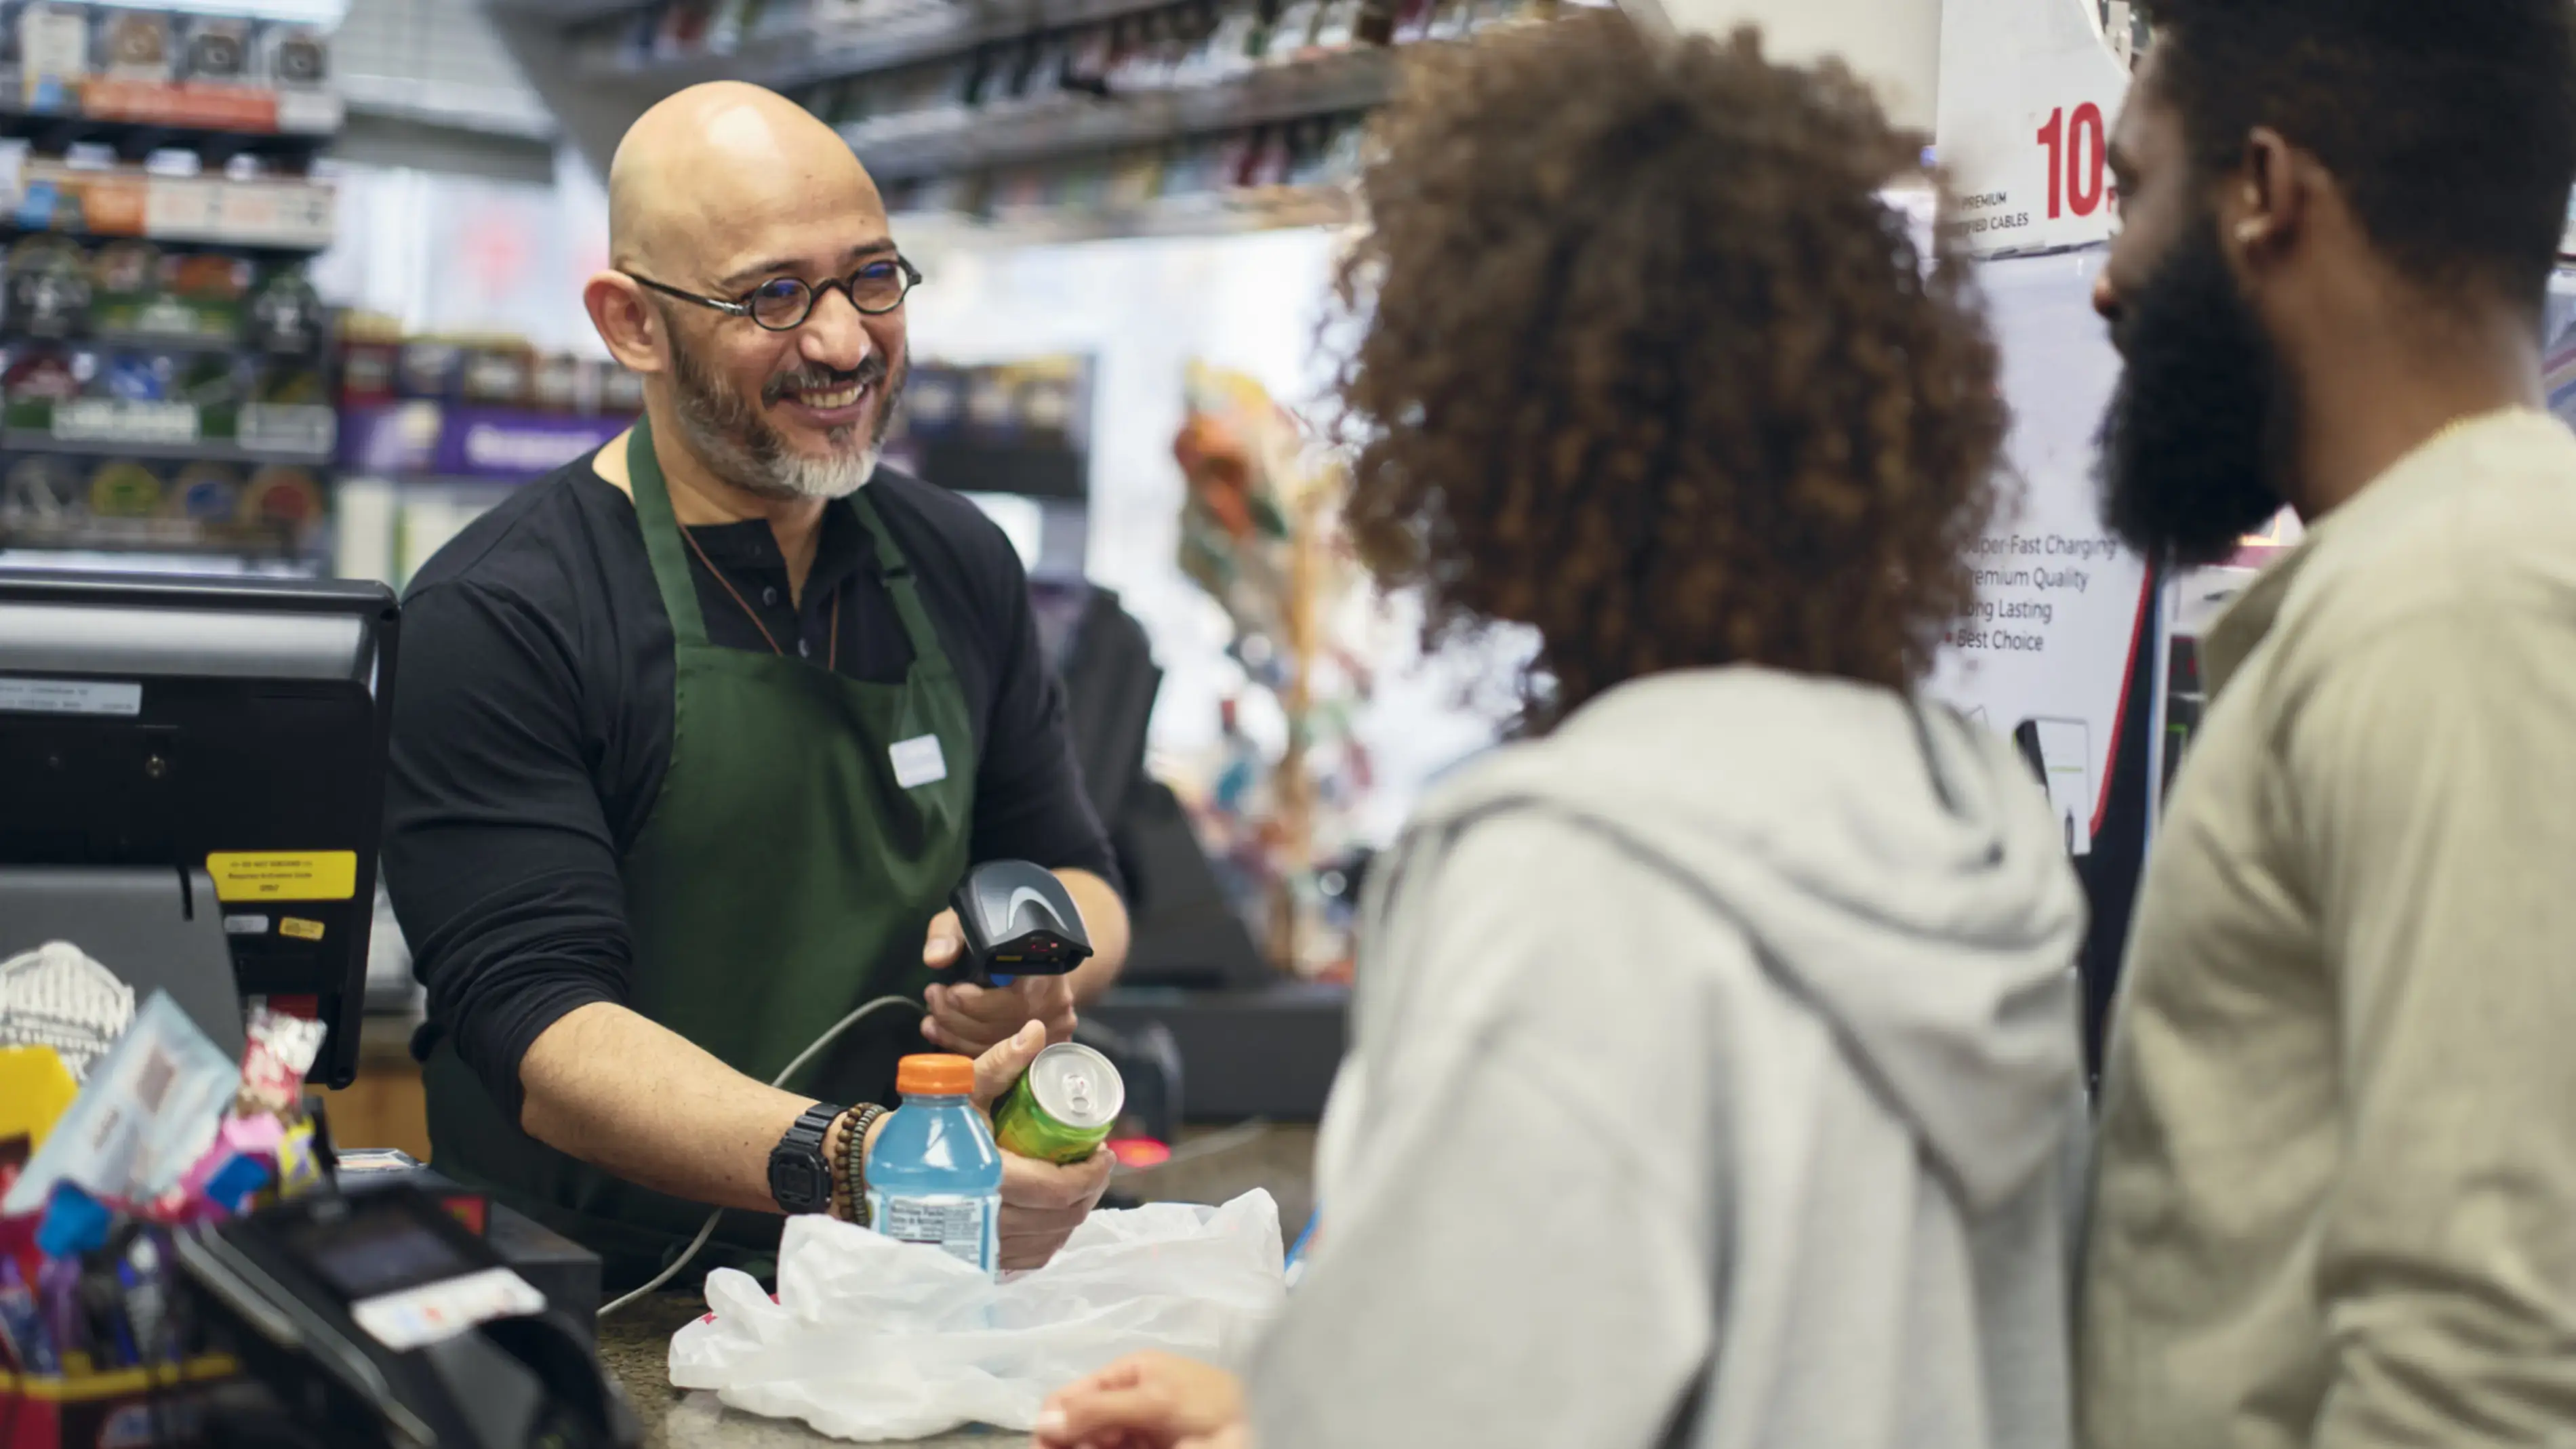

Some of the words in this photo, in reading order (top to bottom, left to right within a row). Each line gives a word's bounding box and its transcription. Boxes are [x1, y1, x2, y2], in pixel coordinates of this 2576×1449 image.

[2037, 101, 2106, 220] 10
[1990, 212, 2029, 230] CABLES
[2046, 534, 2116, 560] Charging
[1971, 566, 2030, 586] remium
[2034, 566, 2090, 593] Quality
[1963, 600, 1994, 622] ong
[1998, 598, 2053, 624] Lasting
[1956, 629, 1988, 649] Best
[1992, 630, 2044, 651] Choice
